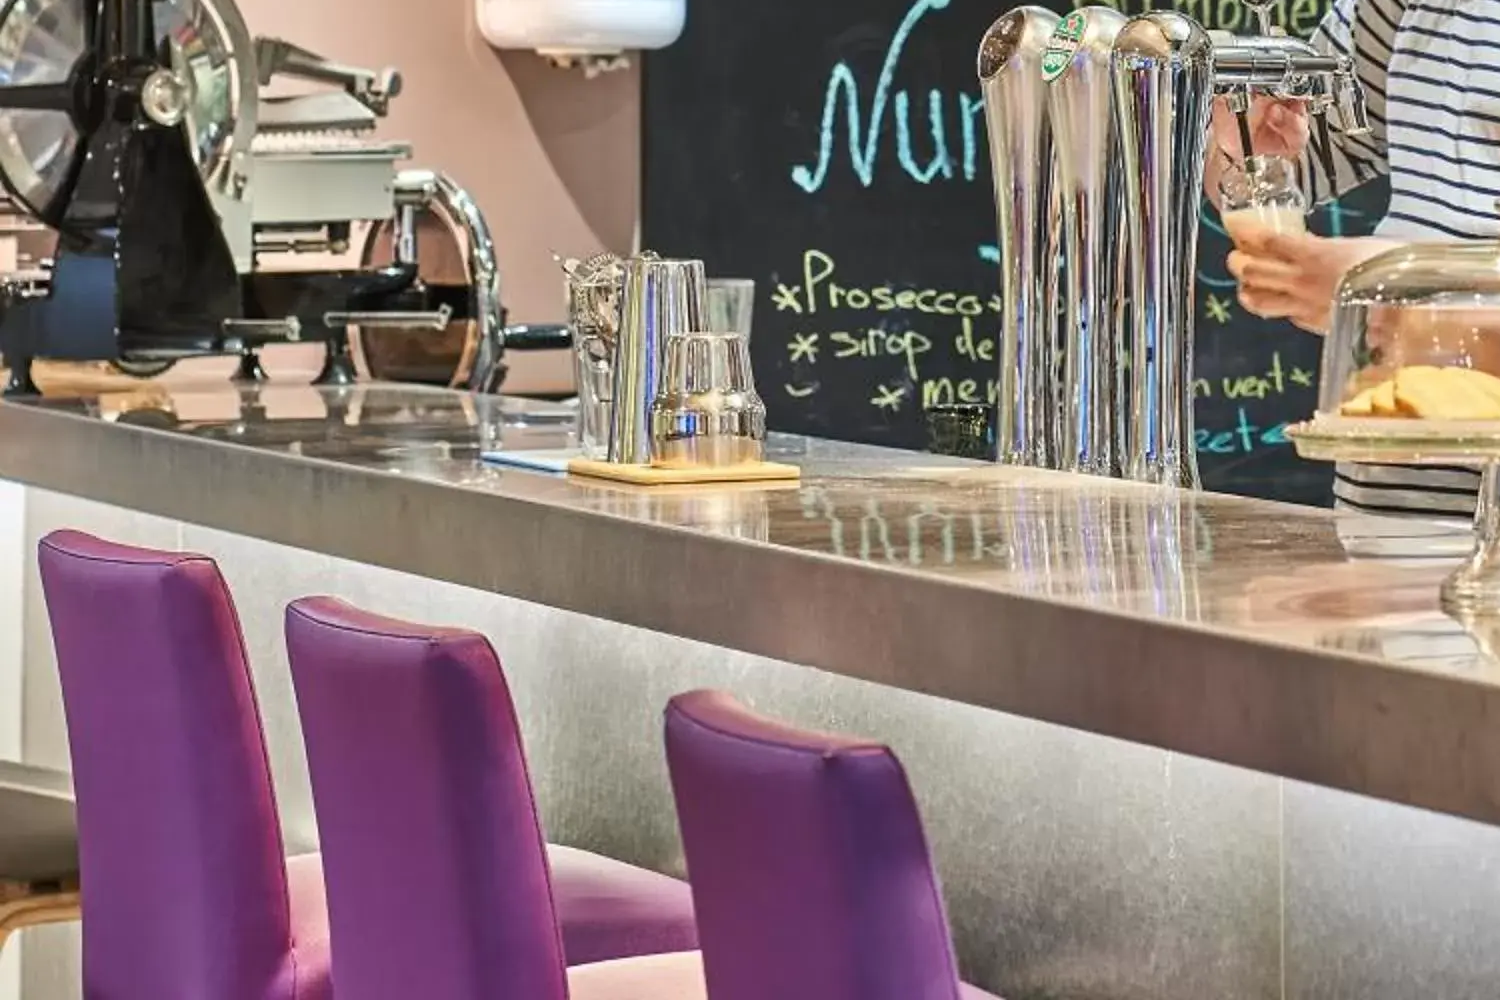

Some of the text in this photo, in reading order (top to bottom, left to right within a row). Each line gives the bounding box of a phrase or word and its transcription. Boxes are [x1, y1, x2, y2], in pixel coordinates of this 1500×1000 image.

[829, 315, 995, 381] sirop de
[1222, 351, 1284, 400] vert
